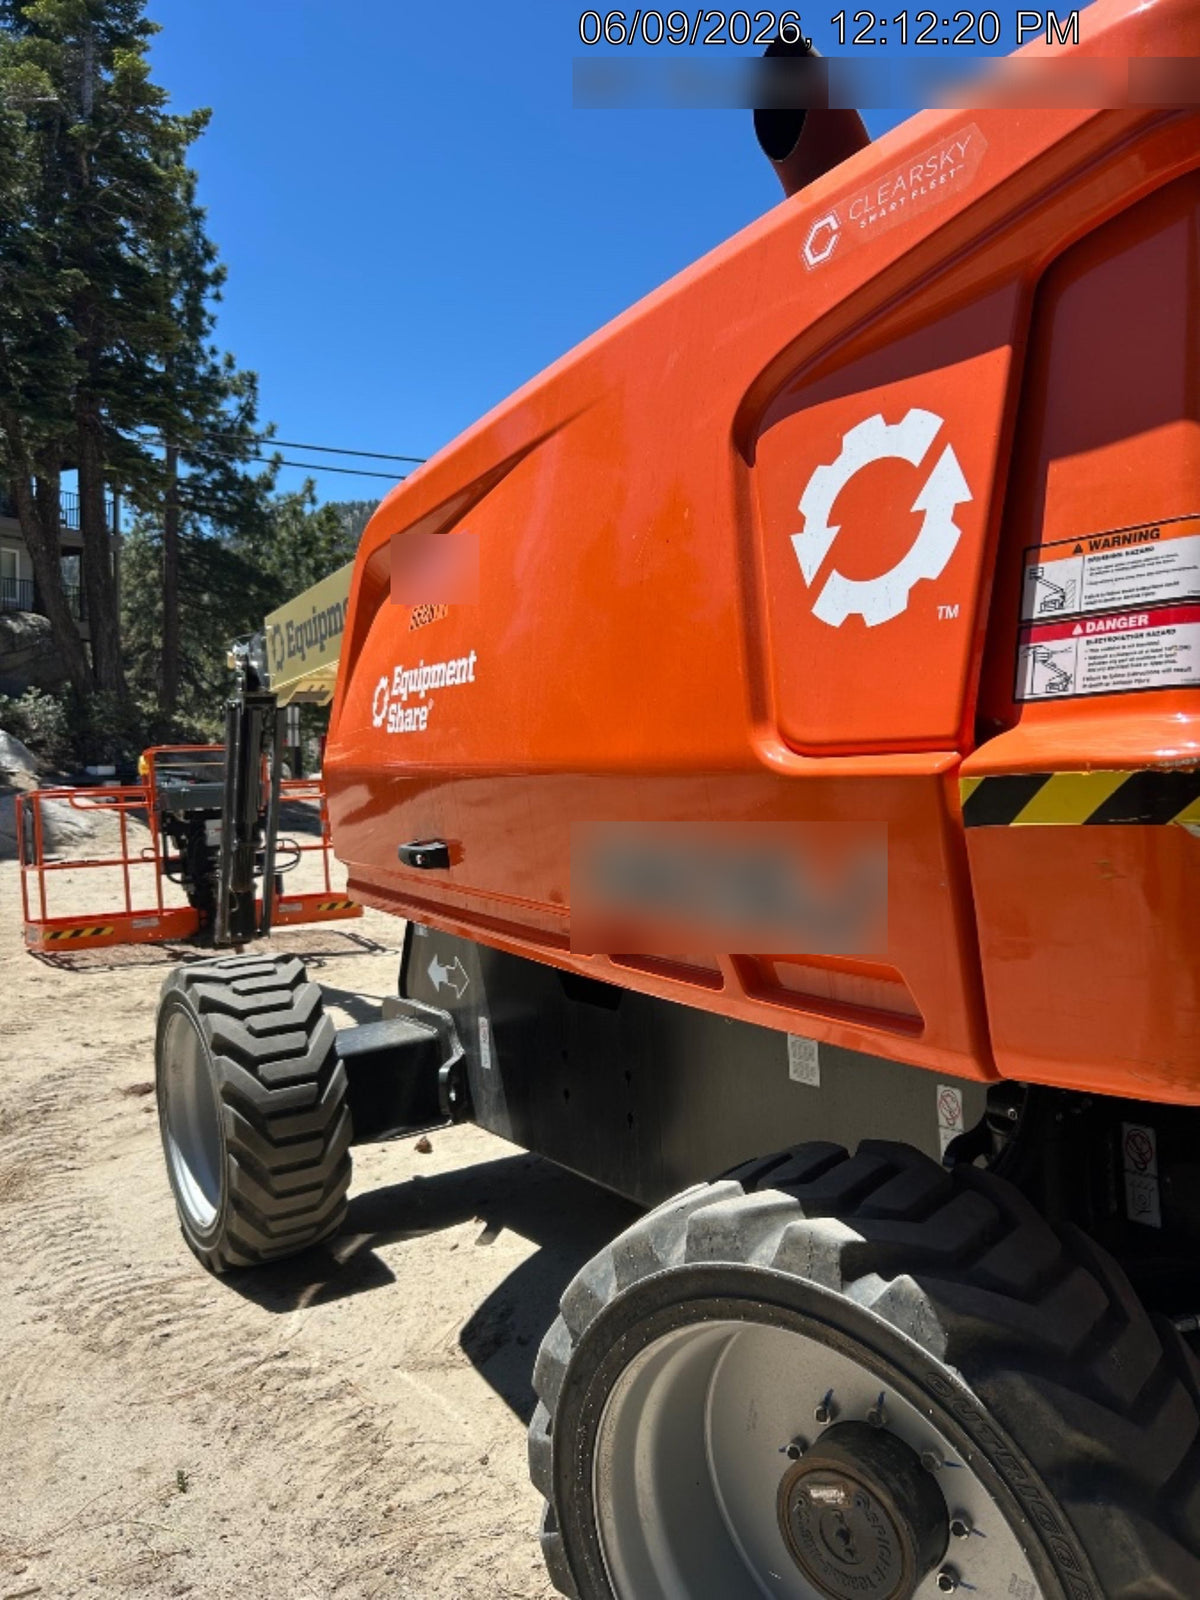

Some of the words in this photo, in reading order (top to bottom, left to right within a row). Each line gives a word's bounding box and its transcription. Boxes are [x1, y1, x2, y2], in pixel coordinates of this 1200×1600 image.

[848, 134, 973, 221] CLEARSKY
[859, 197, 906, 229] SMART
[1088, 528, 1161, 551] WARNING
[936, 604, 960, 621] TM
[1085, 615, 1149, 634] DANGER
[391, 650, 477, 699] Equipment
